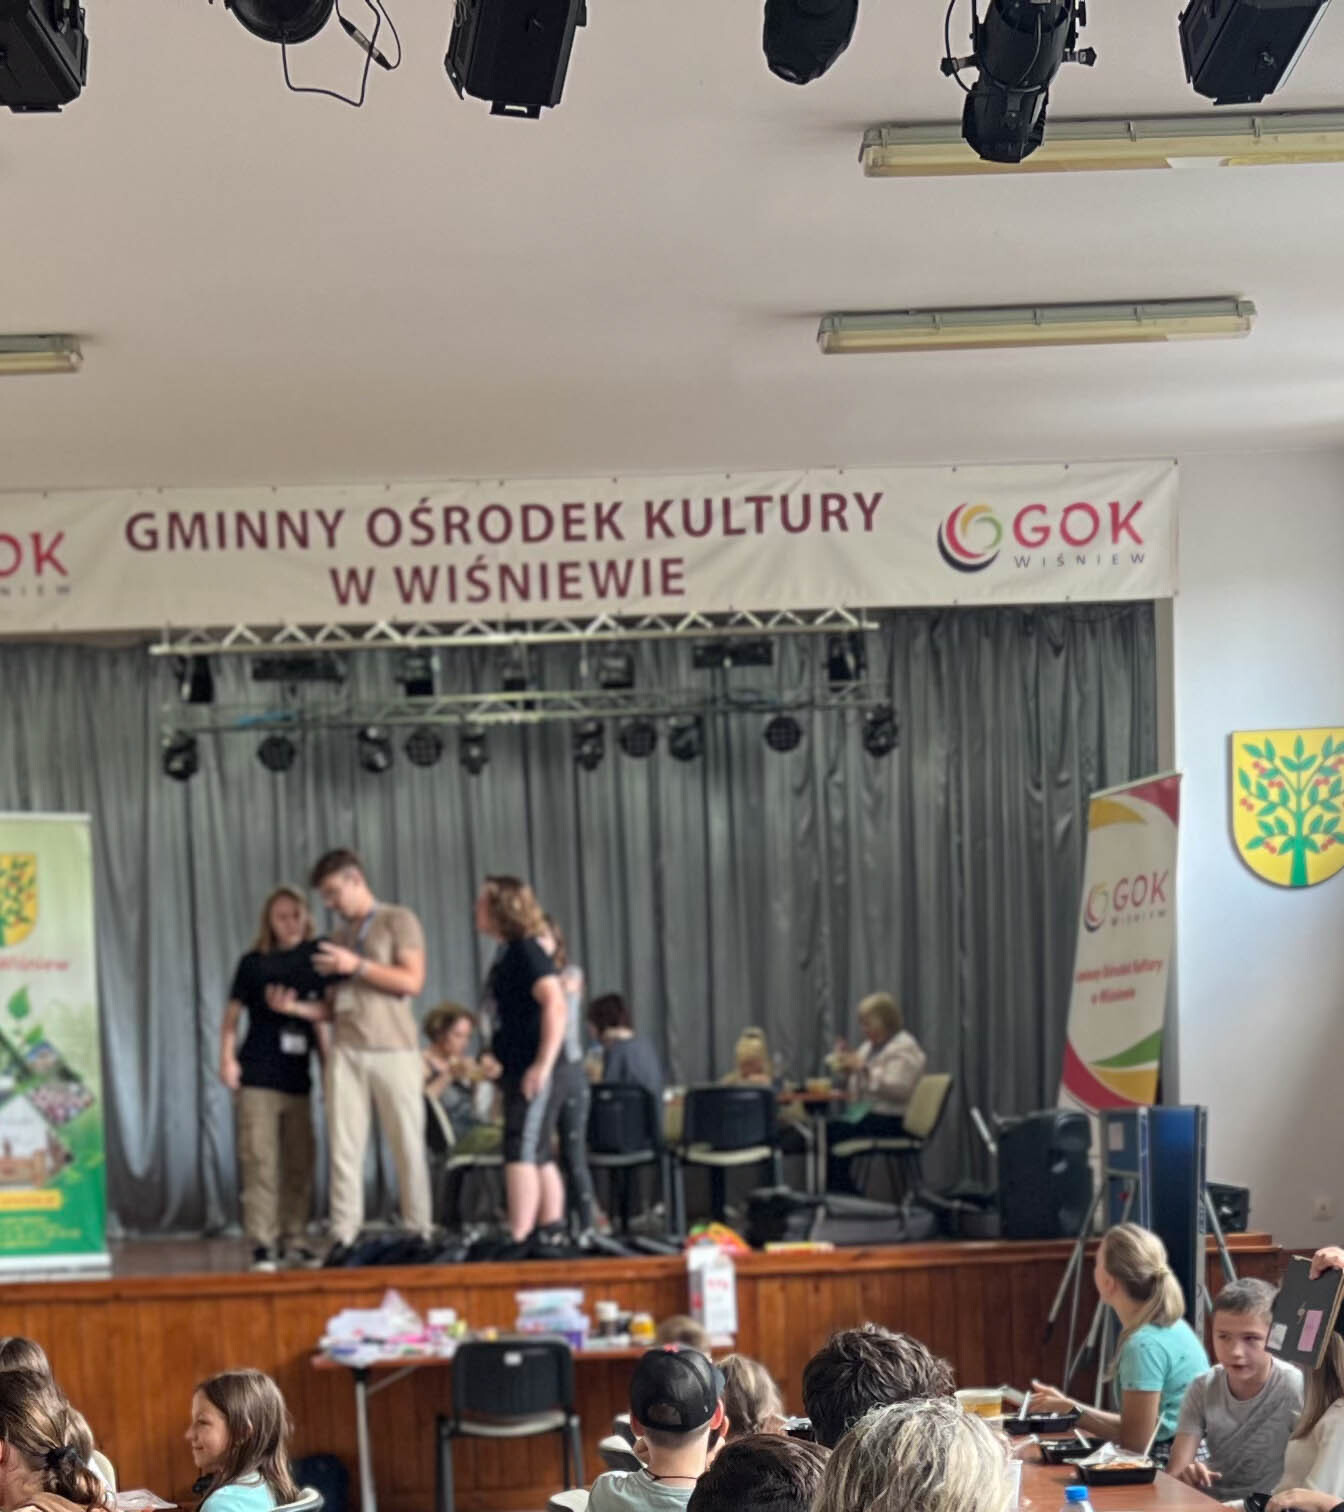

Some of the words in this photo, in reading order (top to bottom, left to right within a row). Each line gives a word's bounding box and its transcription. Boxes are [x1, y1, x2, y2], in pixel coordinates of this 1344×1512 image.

[124, 507, 346, 552] GMINNY
[366, 496, 625, 548] OŚRODEK
[644, 491, 884, 540] KULTURY
[1012, 499, 1144, 549] GOK
[328, 566, 376, 605] W
[393, 553, 686, 605] WIŚNIEWIE
[1014, 552, 1146, 569] WIŚNIEW
[1113, 871, 1168, 911] GOK
